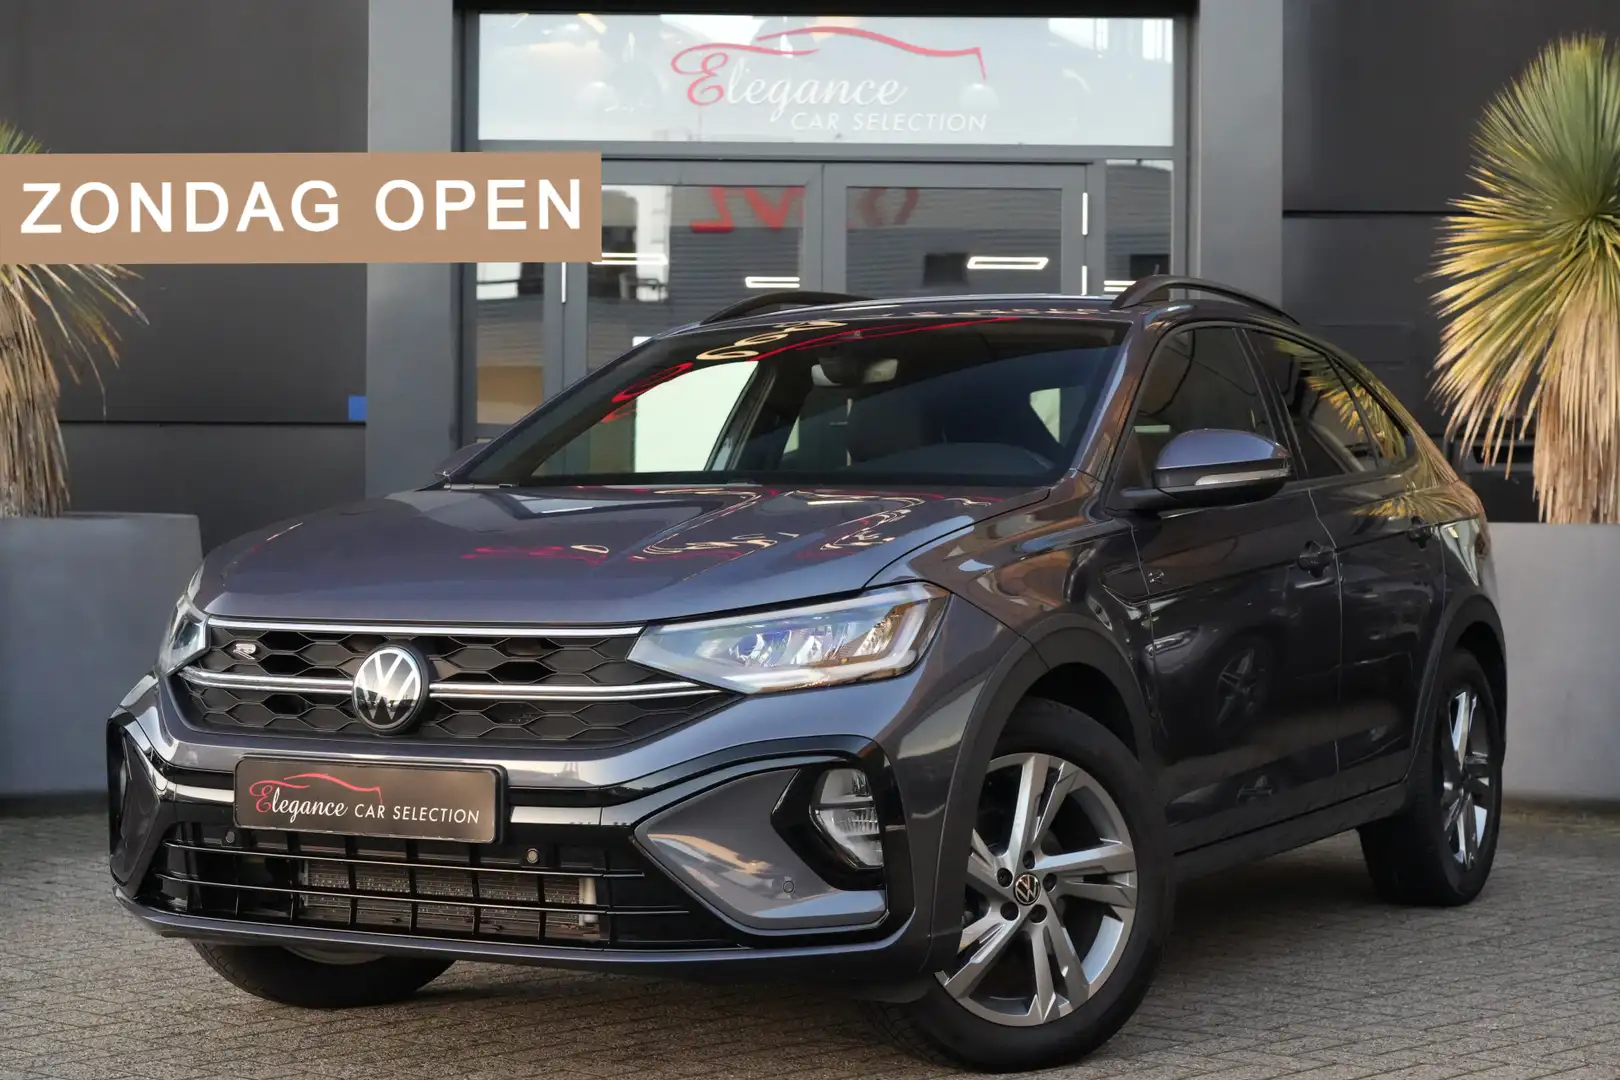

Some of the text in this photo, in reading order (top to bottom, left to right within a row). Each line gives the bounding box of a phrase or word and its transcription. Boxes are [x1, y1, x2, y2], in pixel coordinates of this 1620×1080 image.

[671, 44, 908, 122] Elegance
[791, 112, 987, 132] CAR SELECTION
[249, 780, 480, 824] Elegance CAR SELECTION
